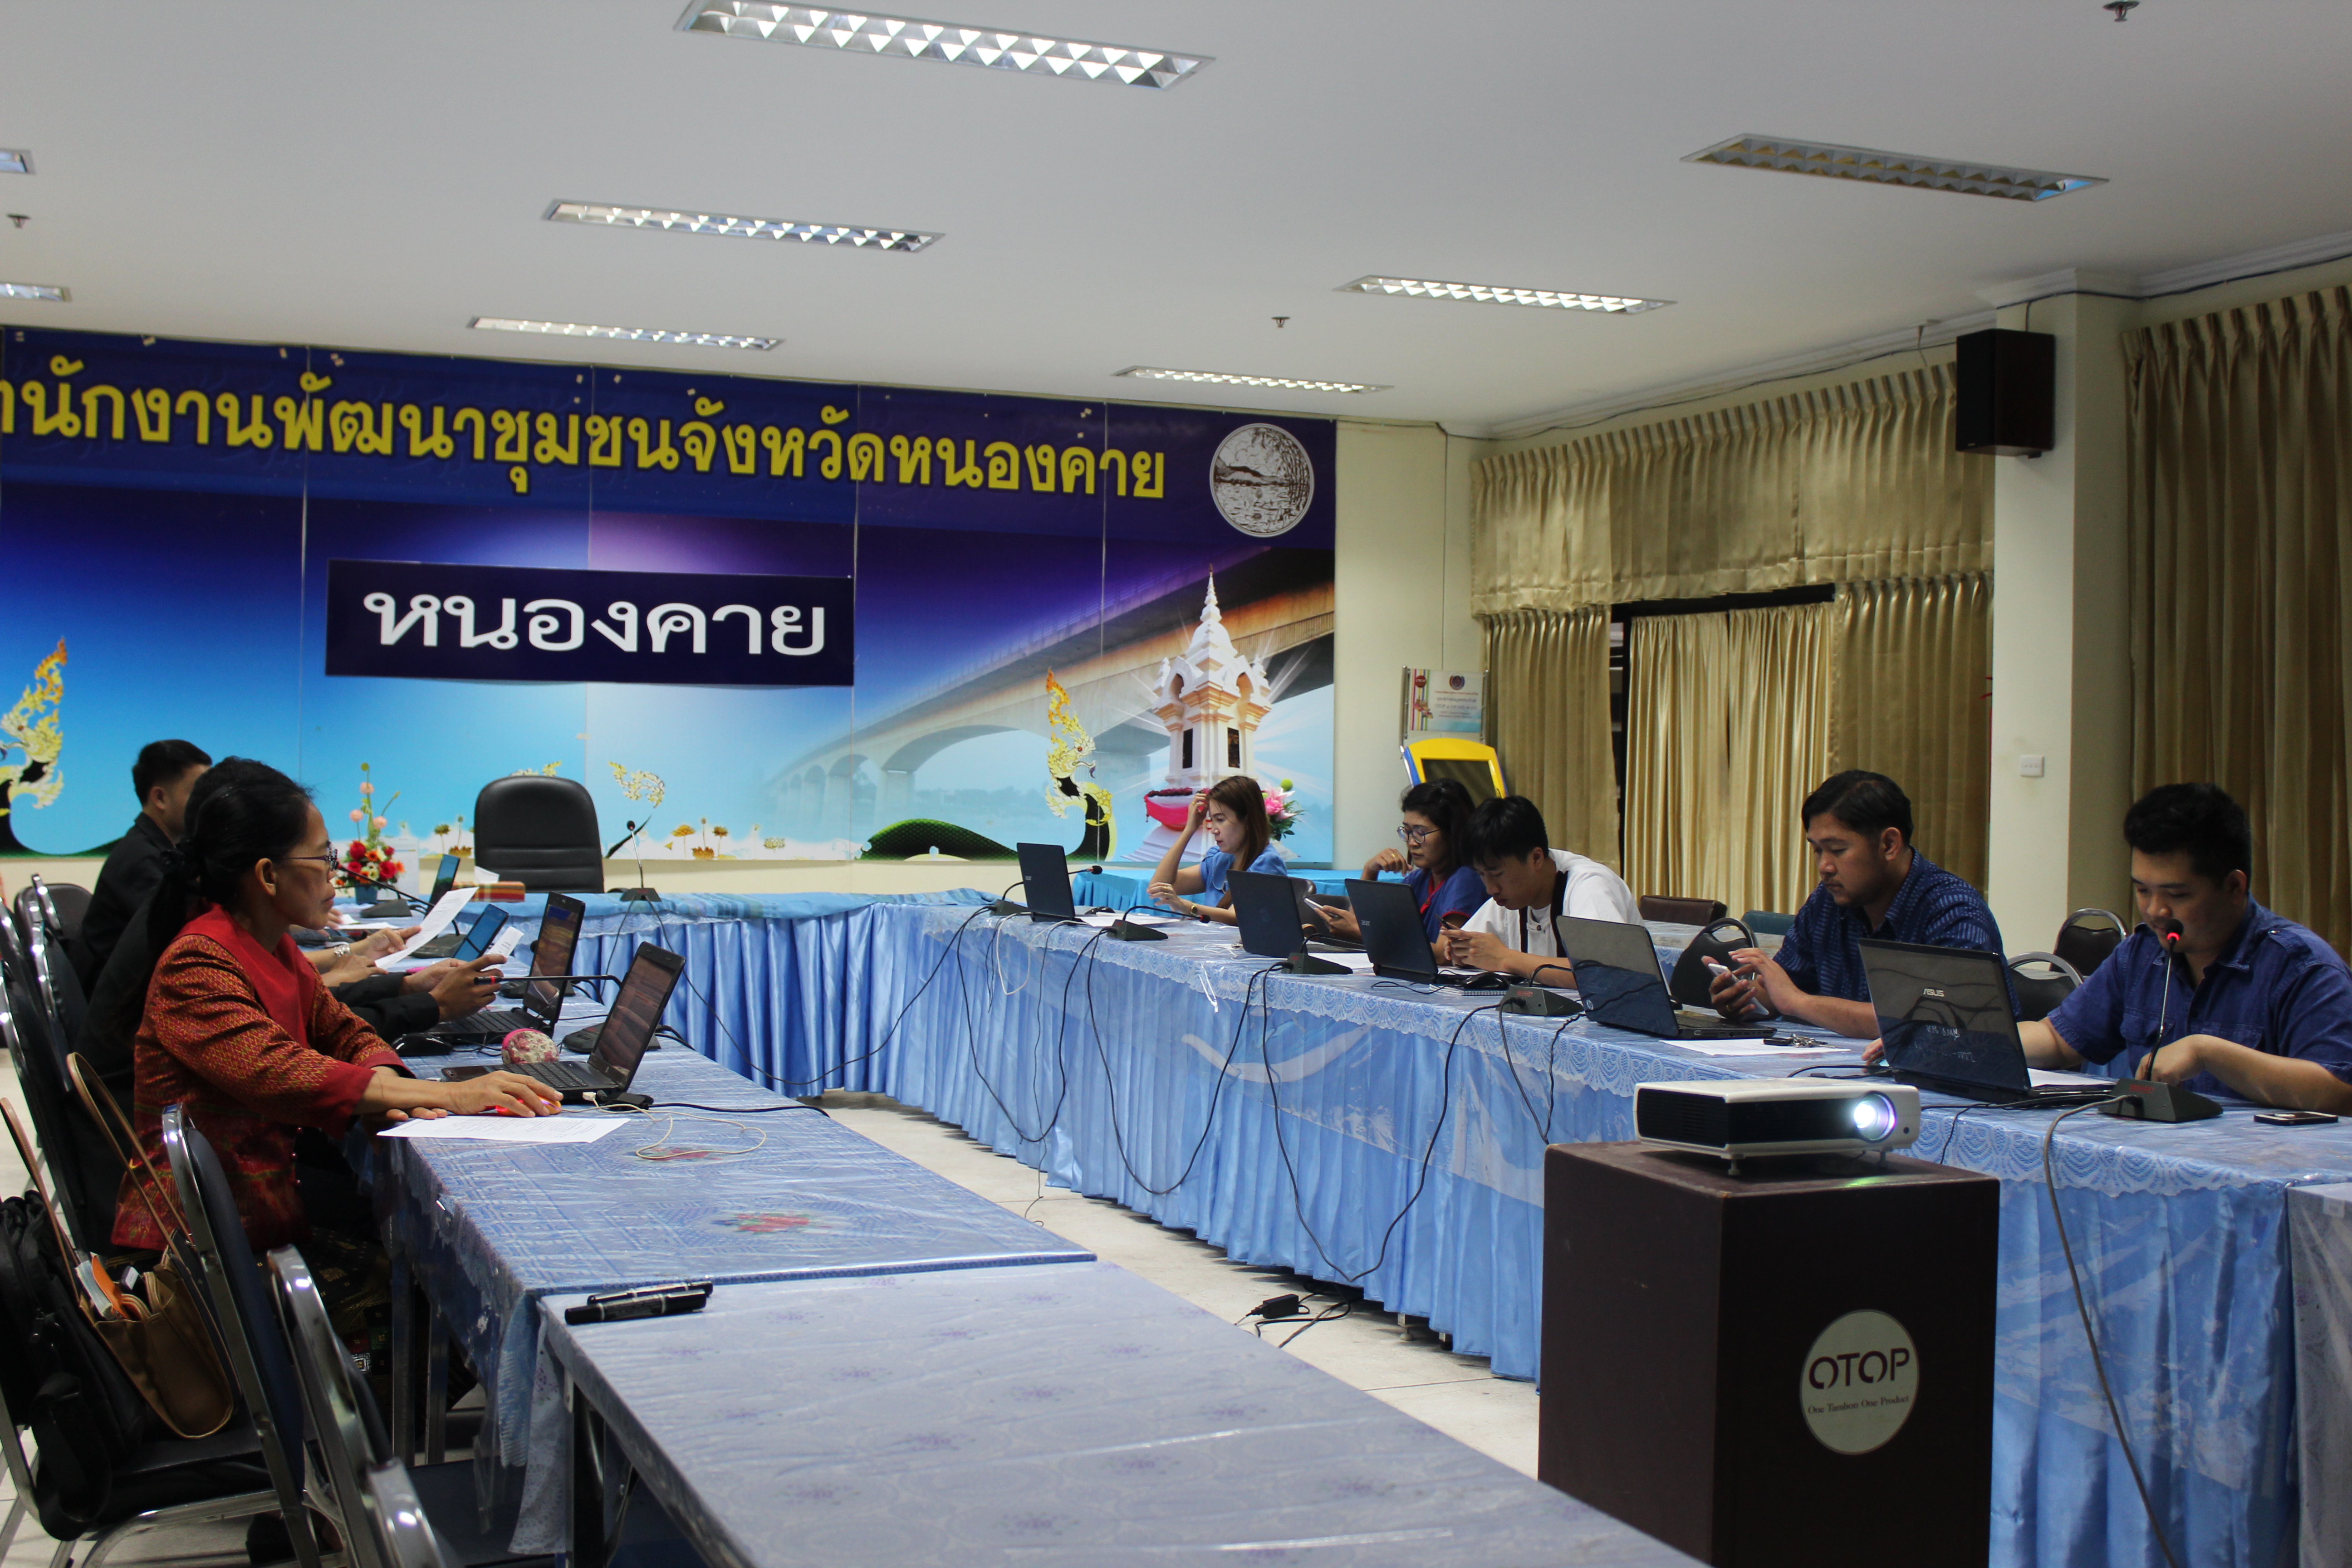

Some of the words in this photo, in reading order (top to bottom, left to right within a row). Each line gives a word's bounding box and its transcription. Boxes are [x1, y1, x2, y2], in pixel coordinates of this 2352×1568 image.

[363, 592, 824, 656] หนองคาย
[1923, 989, 1945, 997] ASUS
[1808, 1348, 1910, 1390] OTOP
[1808, 1405, 1824, 1414] One
[1827, 1402, 1859, 1412] Tambon
[1861, 1399, 1878, 1407] One
[1881, 1395, 1909, 1406] Product
